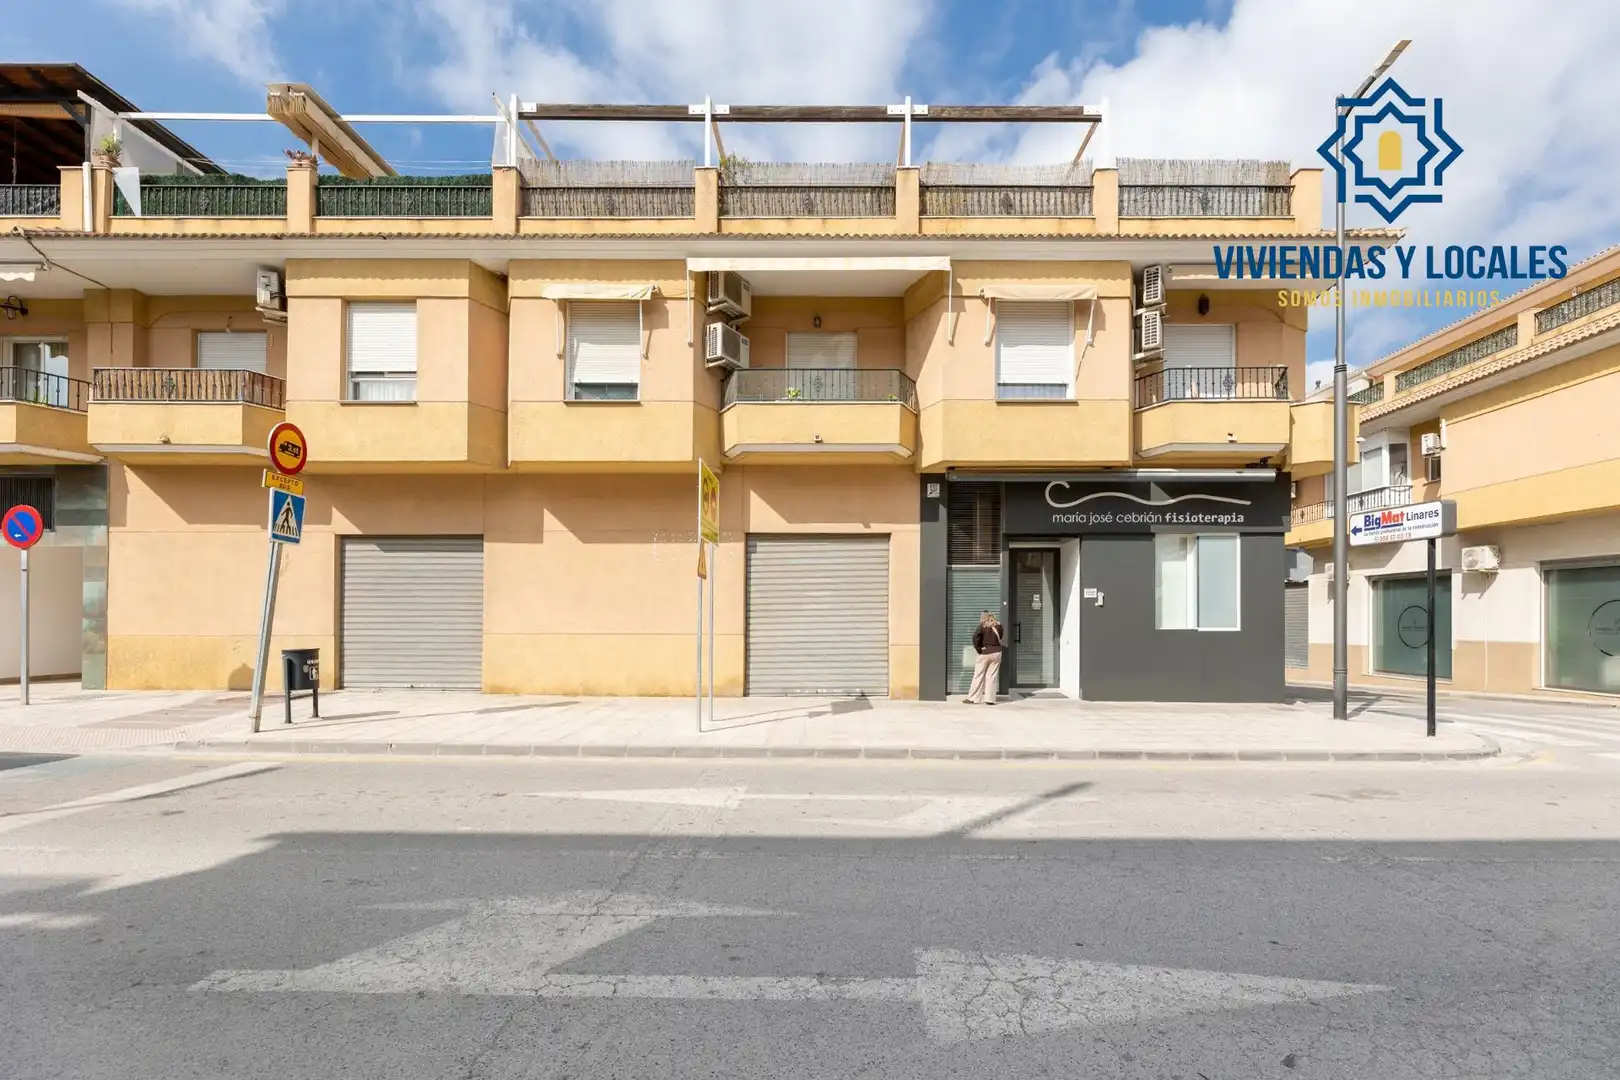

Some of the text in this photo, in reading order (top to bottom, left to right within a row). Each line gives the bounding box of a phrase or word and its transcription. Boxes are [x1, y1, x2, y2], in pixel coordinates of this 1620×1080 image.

[272, 474, 299, 487] EXCEPTO
[1052, 511, 1245, 526] maría josé cebrián fisioterapia
[1364, 509, 1439, 529] BigMat Linares
